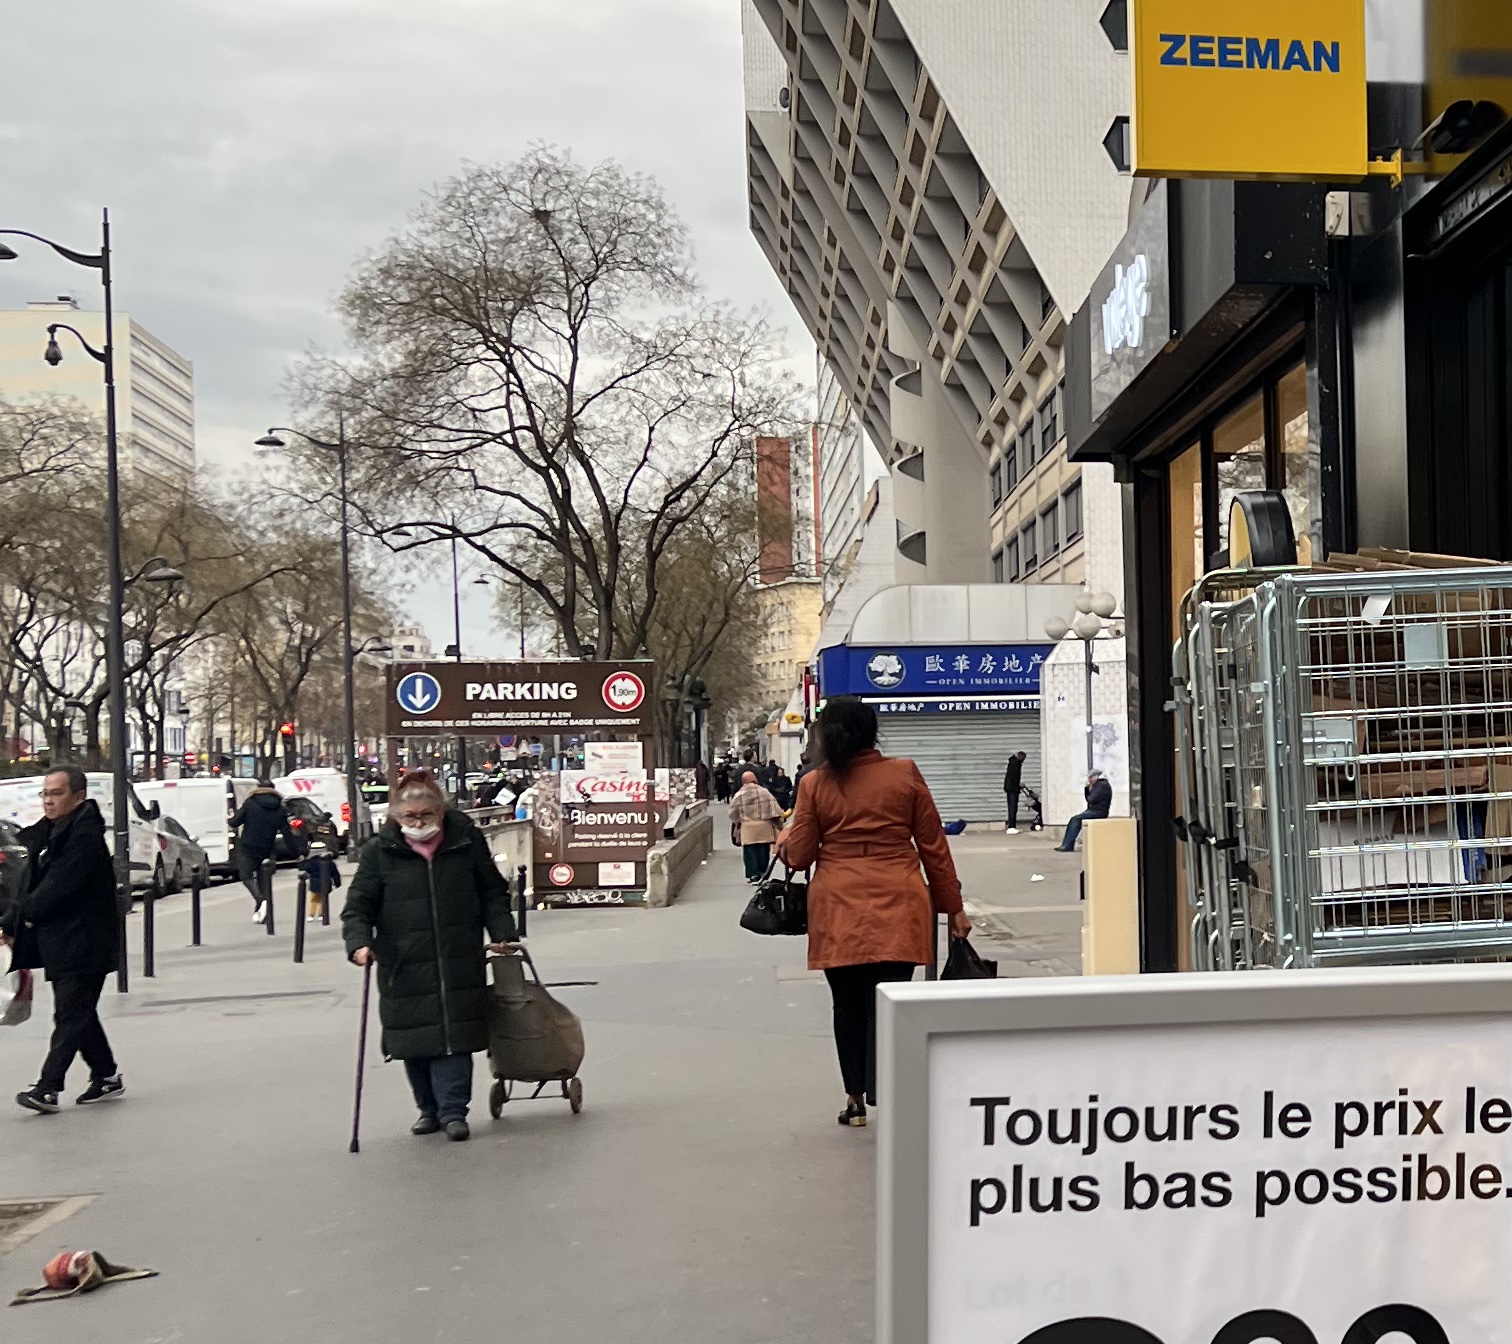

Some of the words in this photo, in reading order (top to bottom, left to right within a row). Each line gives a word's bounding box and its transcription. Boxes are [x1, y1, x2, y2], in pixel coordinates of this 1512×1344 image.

[1159, 33, 1340, 73] ZEEMAN
[611, 684, 637, 697] 1,90m
[938, 678, 965, 686] OPEN
[970, 677, 1031, 685] IMMOBILIER
[466, 682, 578, 700] PARKING
[939, 702, 971, 712] OPEN
[969, 1094, 1240, 1155] Toujours
[1263, 1090, 1313, 1139] le
[1334, 1087, 1444, 1149] prix
[969, 1164, 1101, 1227] plus
[1123, 1160, 1233, 1211] bas
